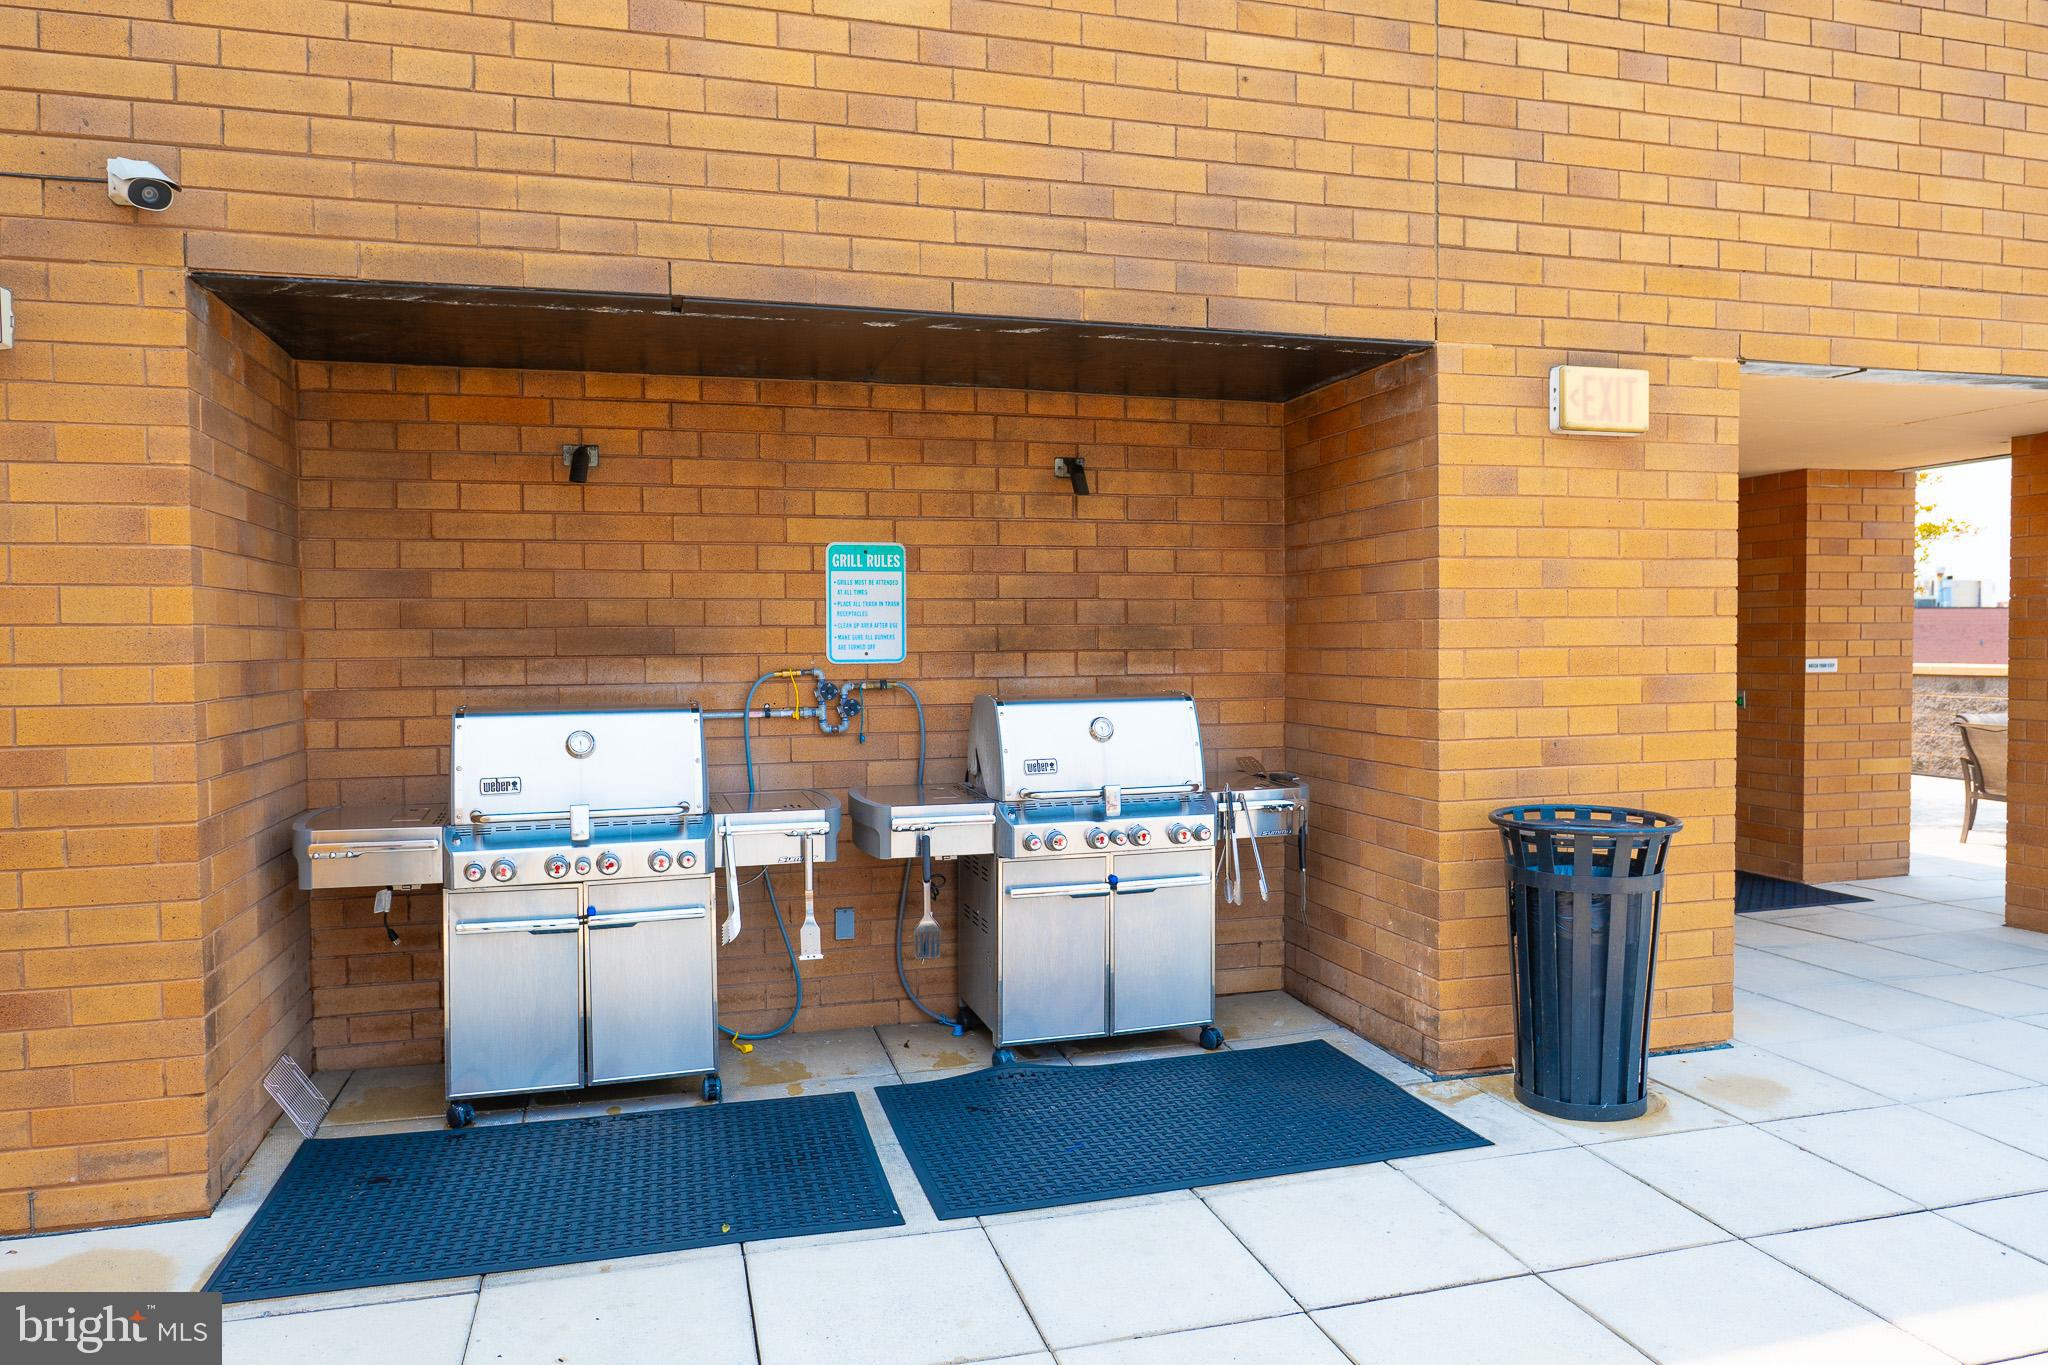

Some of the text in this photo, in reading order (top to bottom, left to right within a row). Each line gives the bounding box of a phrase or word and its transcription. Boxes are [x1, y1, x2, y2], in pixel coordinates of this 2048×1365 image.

[1583, 375, 1638, 423] EXIT
[832, 553, 901, 568] GRILL RULES
[1027, 760, 1049, 772] weber
[483, 778, 511, 792] weber
